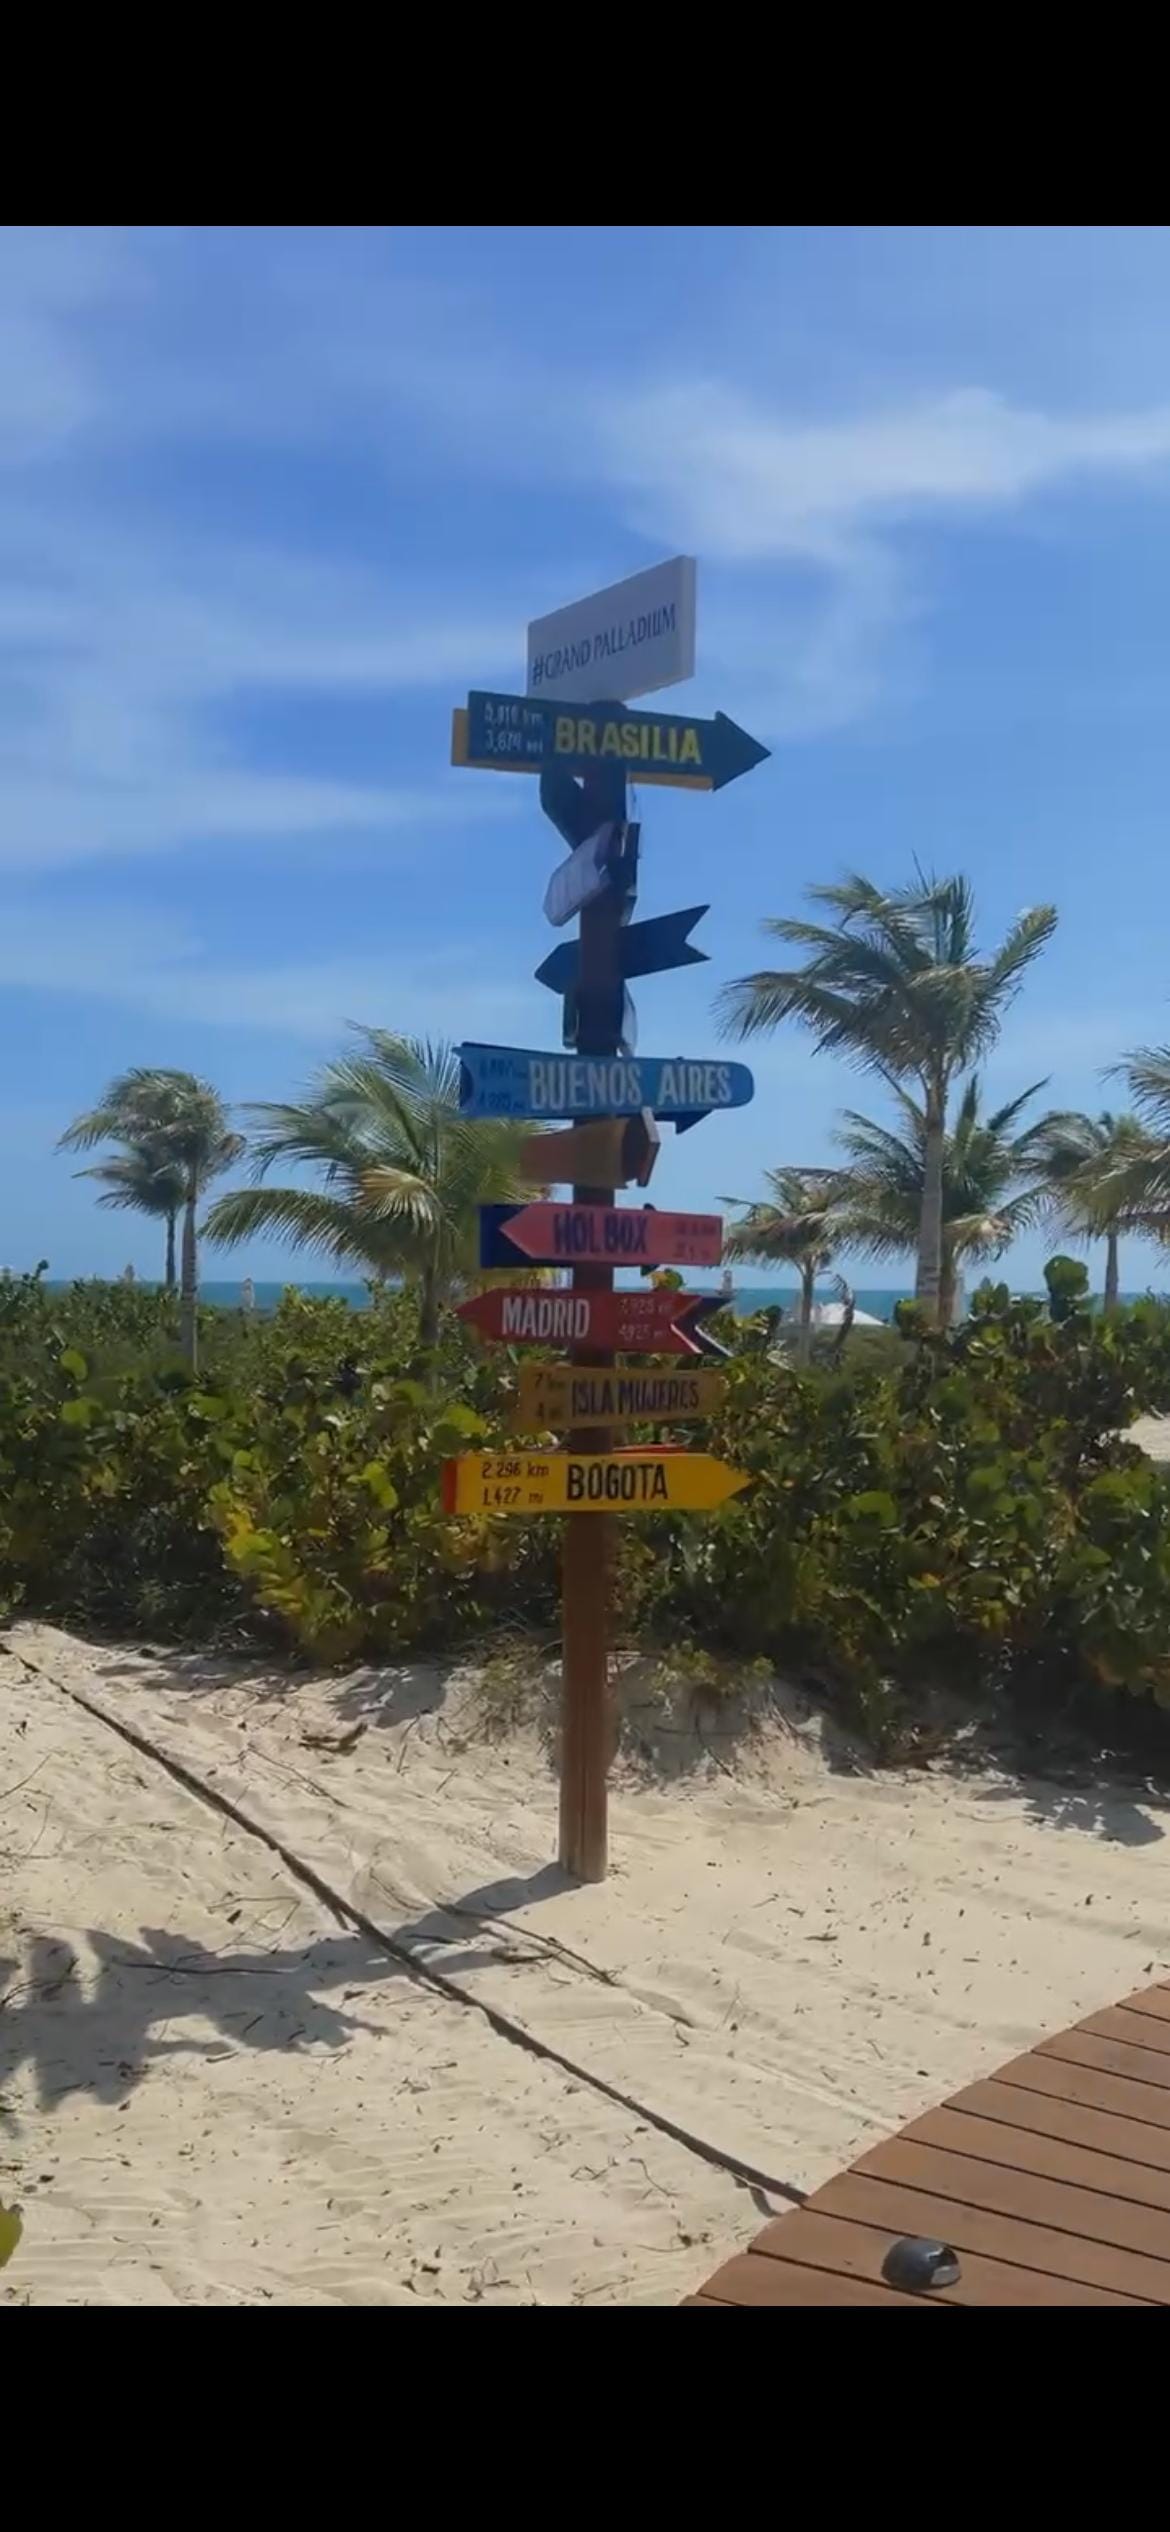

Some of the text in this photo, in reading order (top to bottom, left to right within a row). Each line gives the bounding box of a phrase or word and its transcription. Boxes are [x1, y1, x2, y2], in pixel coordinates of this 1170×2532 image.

[532, 602, 677, 687] #GRAND PALLADIUM
[555, 718, 702, 764] BRASILIA
[529, 1059, 642, 1111] BUENOS
[657, 1062, 734, 1106] AIRES
[501, 1297, 591, 1339] MADRID
[571, 1379, 614, 1418] ISLA
[617, 1379, 700, 1415] MUJERES
[527, 1462, 549, 1477] km
[566, 1463, 668, 1501] BOGOTA
